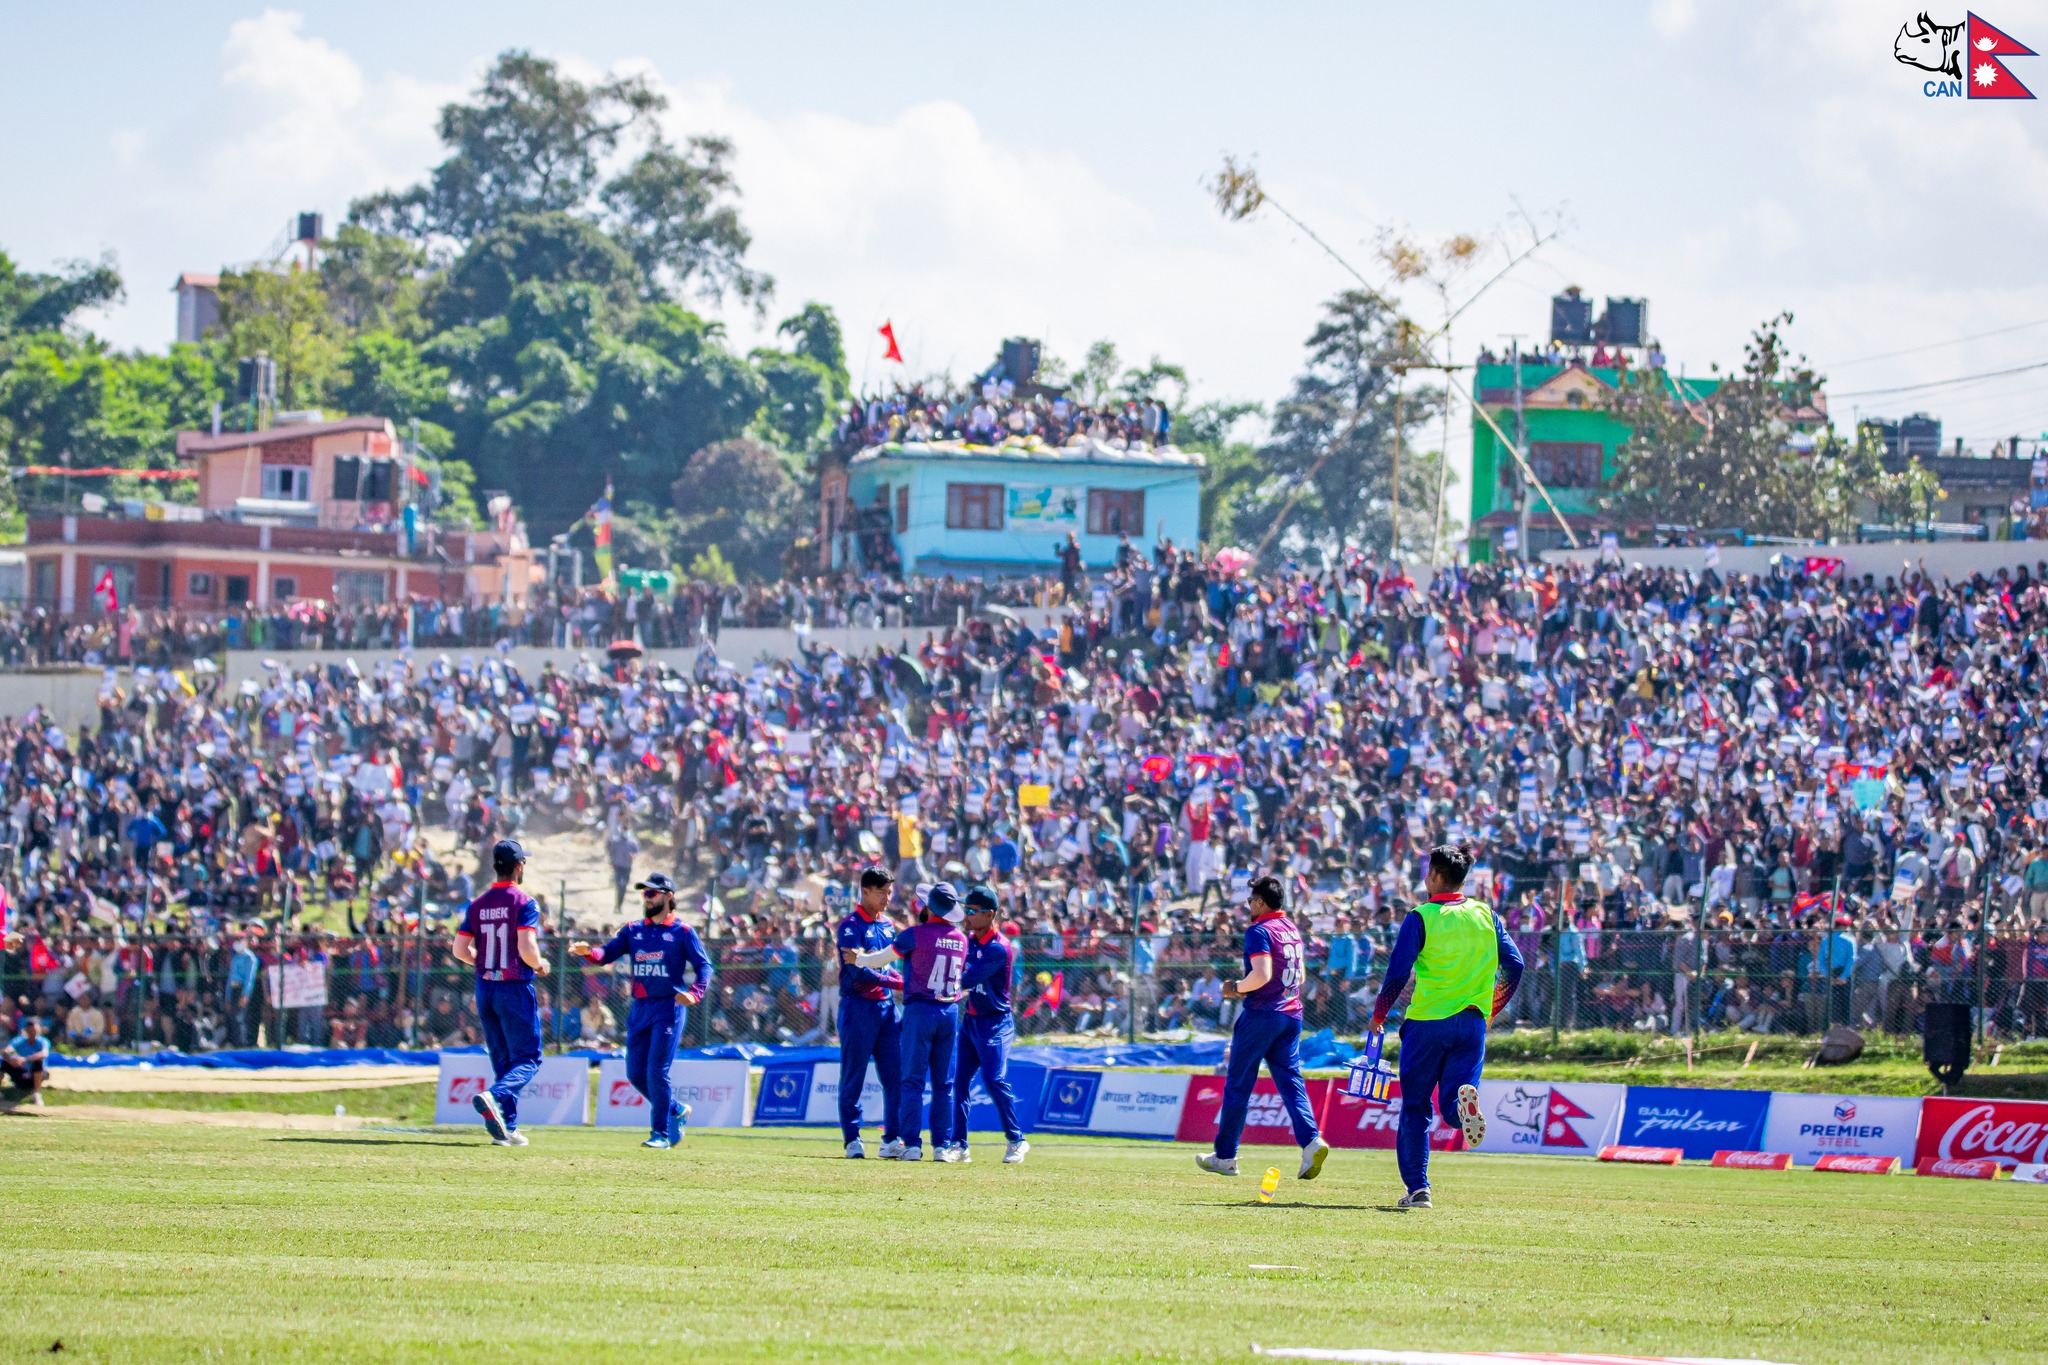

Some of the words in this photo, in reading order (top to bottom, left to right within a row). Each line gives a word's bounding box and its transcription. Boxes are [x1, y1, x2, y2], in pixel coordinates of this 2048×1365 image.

[479, 907, 509, 920] BIBEK
[480, 923, 509, 969] 11
[935, 937, 964, 951] AIREE
[927, 954, 962, 994] 45
[1638, 1106, 1689, 1117] BAJAJ
[1800, 1124, 1884, 1138] PREMIER
[1512, 1132, 1539, 1145] CAN
[1818, 1136, 1861, 1148] STEEL
[1930, 1158, 1986, 1176] Coca-Cola
